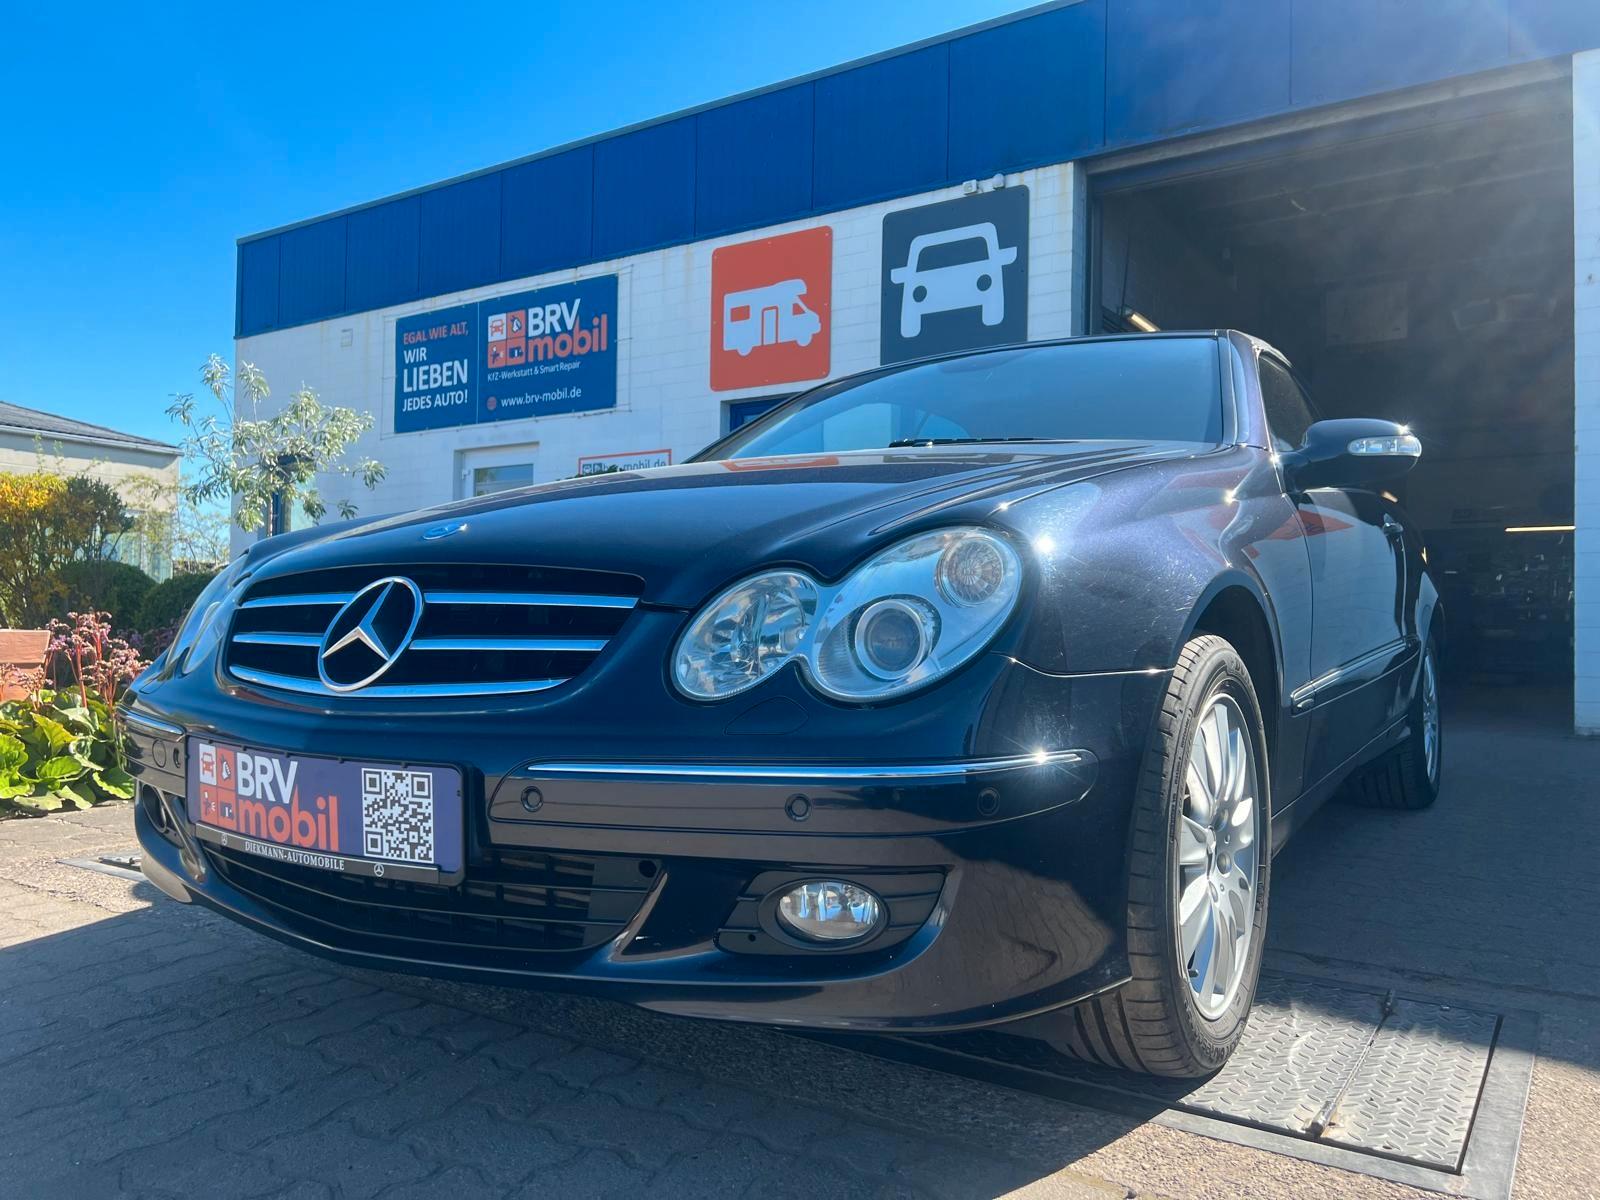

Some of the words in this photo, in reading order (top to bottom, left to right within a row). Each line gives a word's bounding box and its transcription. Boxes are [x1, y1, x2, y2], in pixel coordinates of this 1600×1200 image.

[404, 331, 427, 345] EGAL
[429, 327, 447, 340] WIE
[449, 322, 469, 336] ALT,
[528, 299, 581, 337] BRV
[528, 313, 607, 362] mobil
[404, 347, 427, 363] WIR
[534, 368, 539, 376] &
[540, 364, 559, 374] Smart
[560, 361, 581, 373] Repair
[403, 359, 468, 392] LIEBEN
[402, 394, 431, 412] JEDES
[434, 389, 468, 406] AUTO!
[501, 387, 582, 407] www.brv-mobil.de
[236, 752, 298, 804] BRV
[239, 784, 339, 851] mobil
[244, 840, 345, 871] DIEKMANN-AUTOMOBILE
